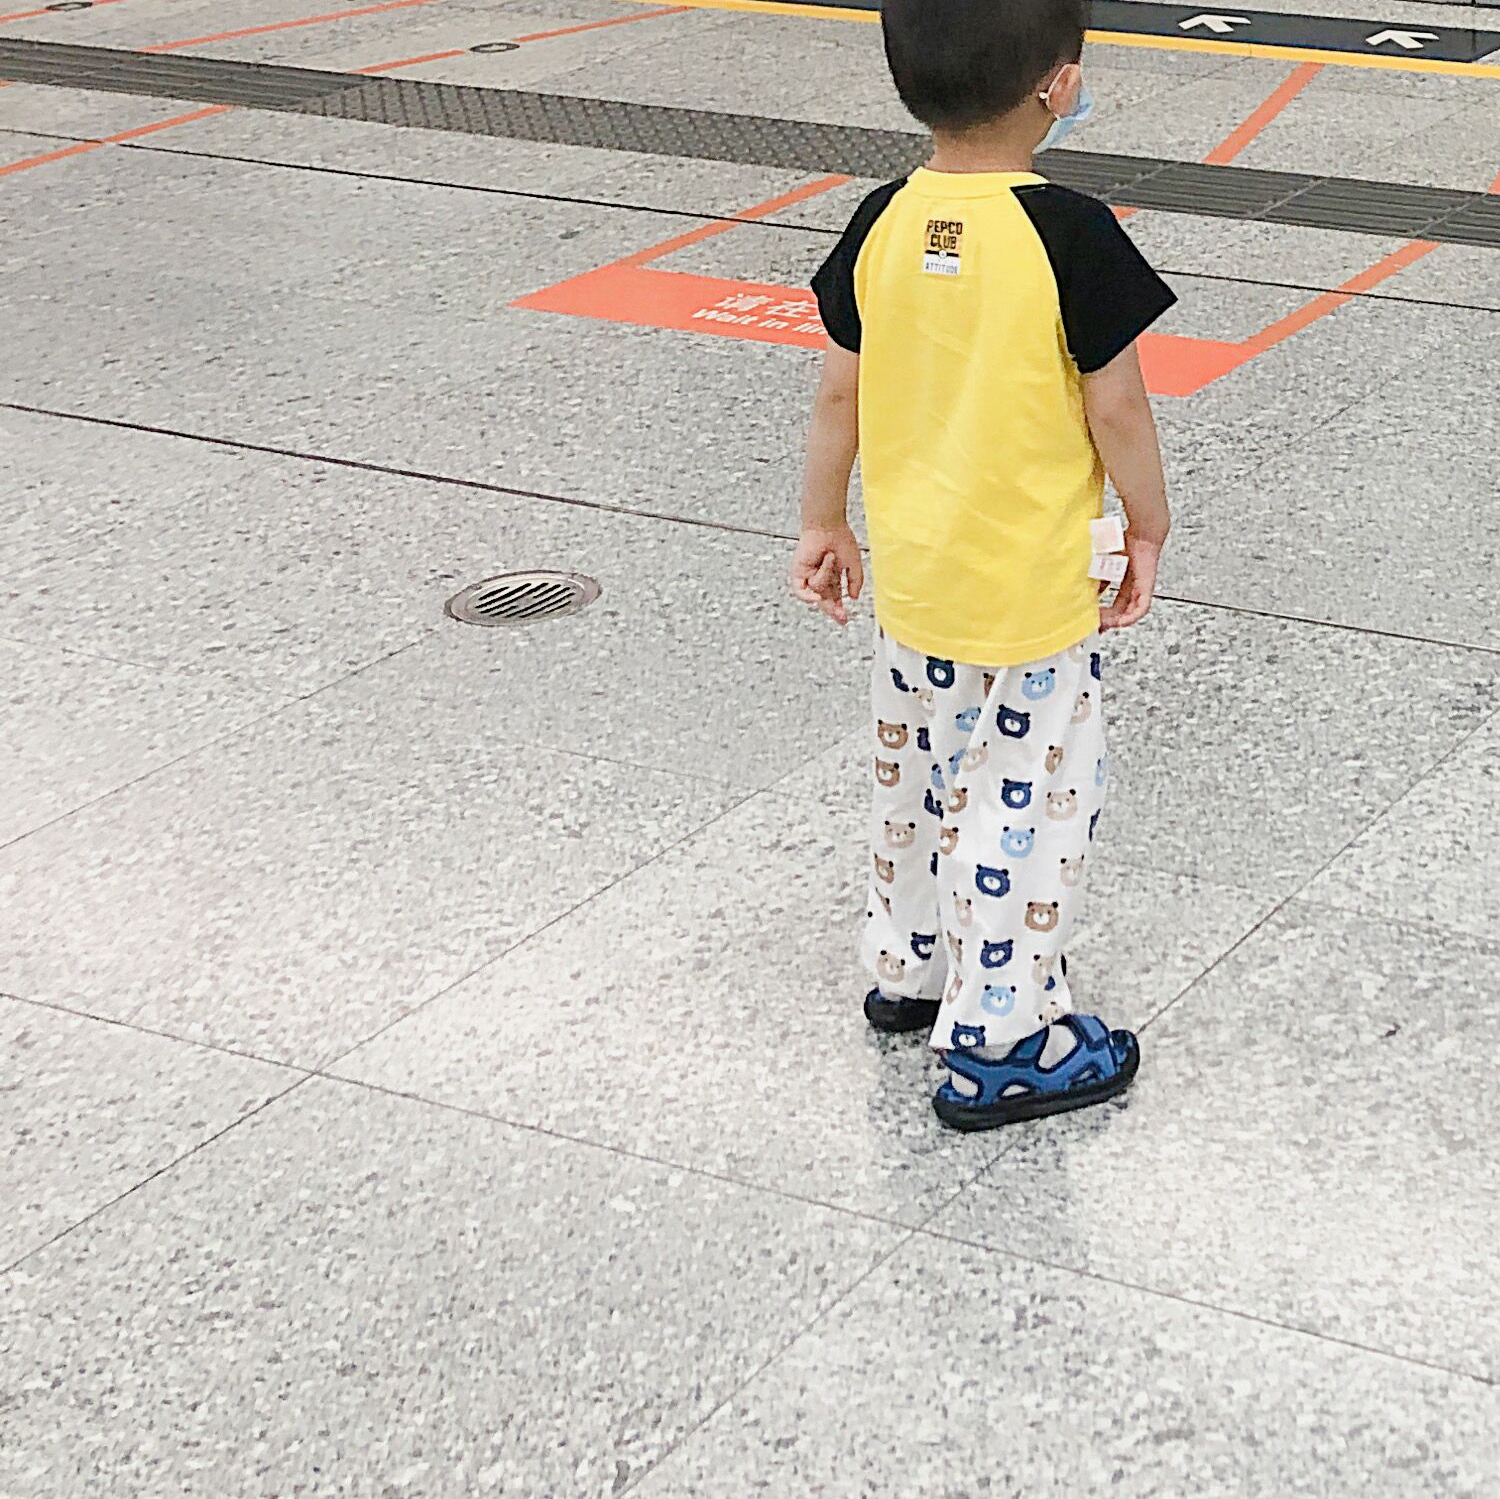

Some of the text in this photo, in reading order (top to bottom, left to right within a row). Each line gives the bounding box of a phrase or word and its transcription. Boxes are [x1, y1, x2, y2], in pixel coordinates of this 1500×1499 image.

[926, 220, 963, 235] PEPCO
[930, 234, 957, 249] CLUB
[714, 293, 821, 320] 请在
[692, 308, 828, 335] Wait in lin
